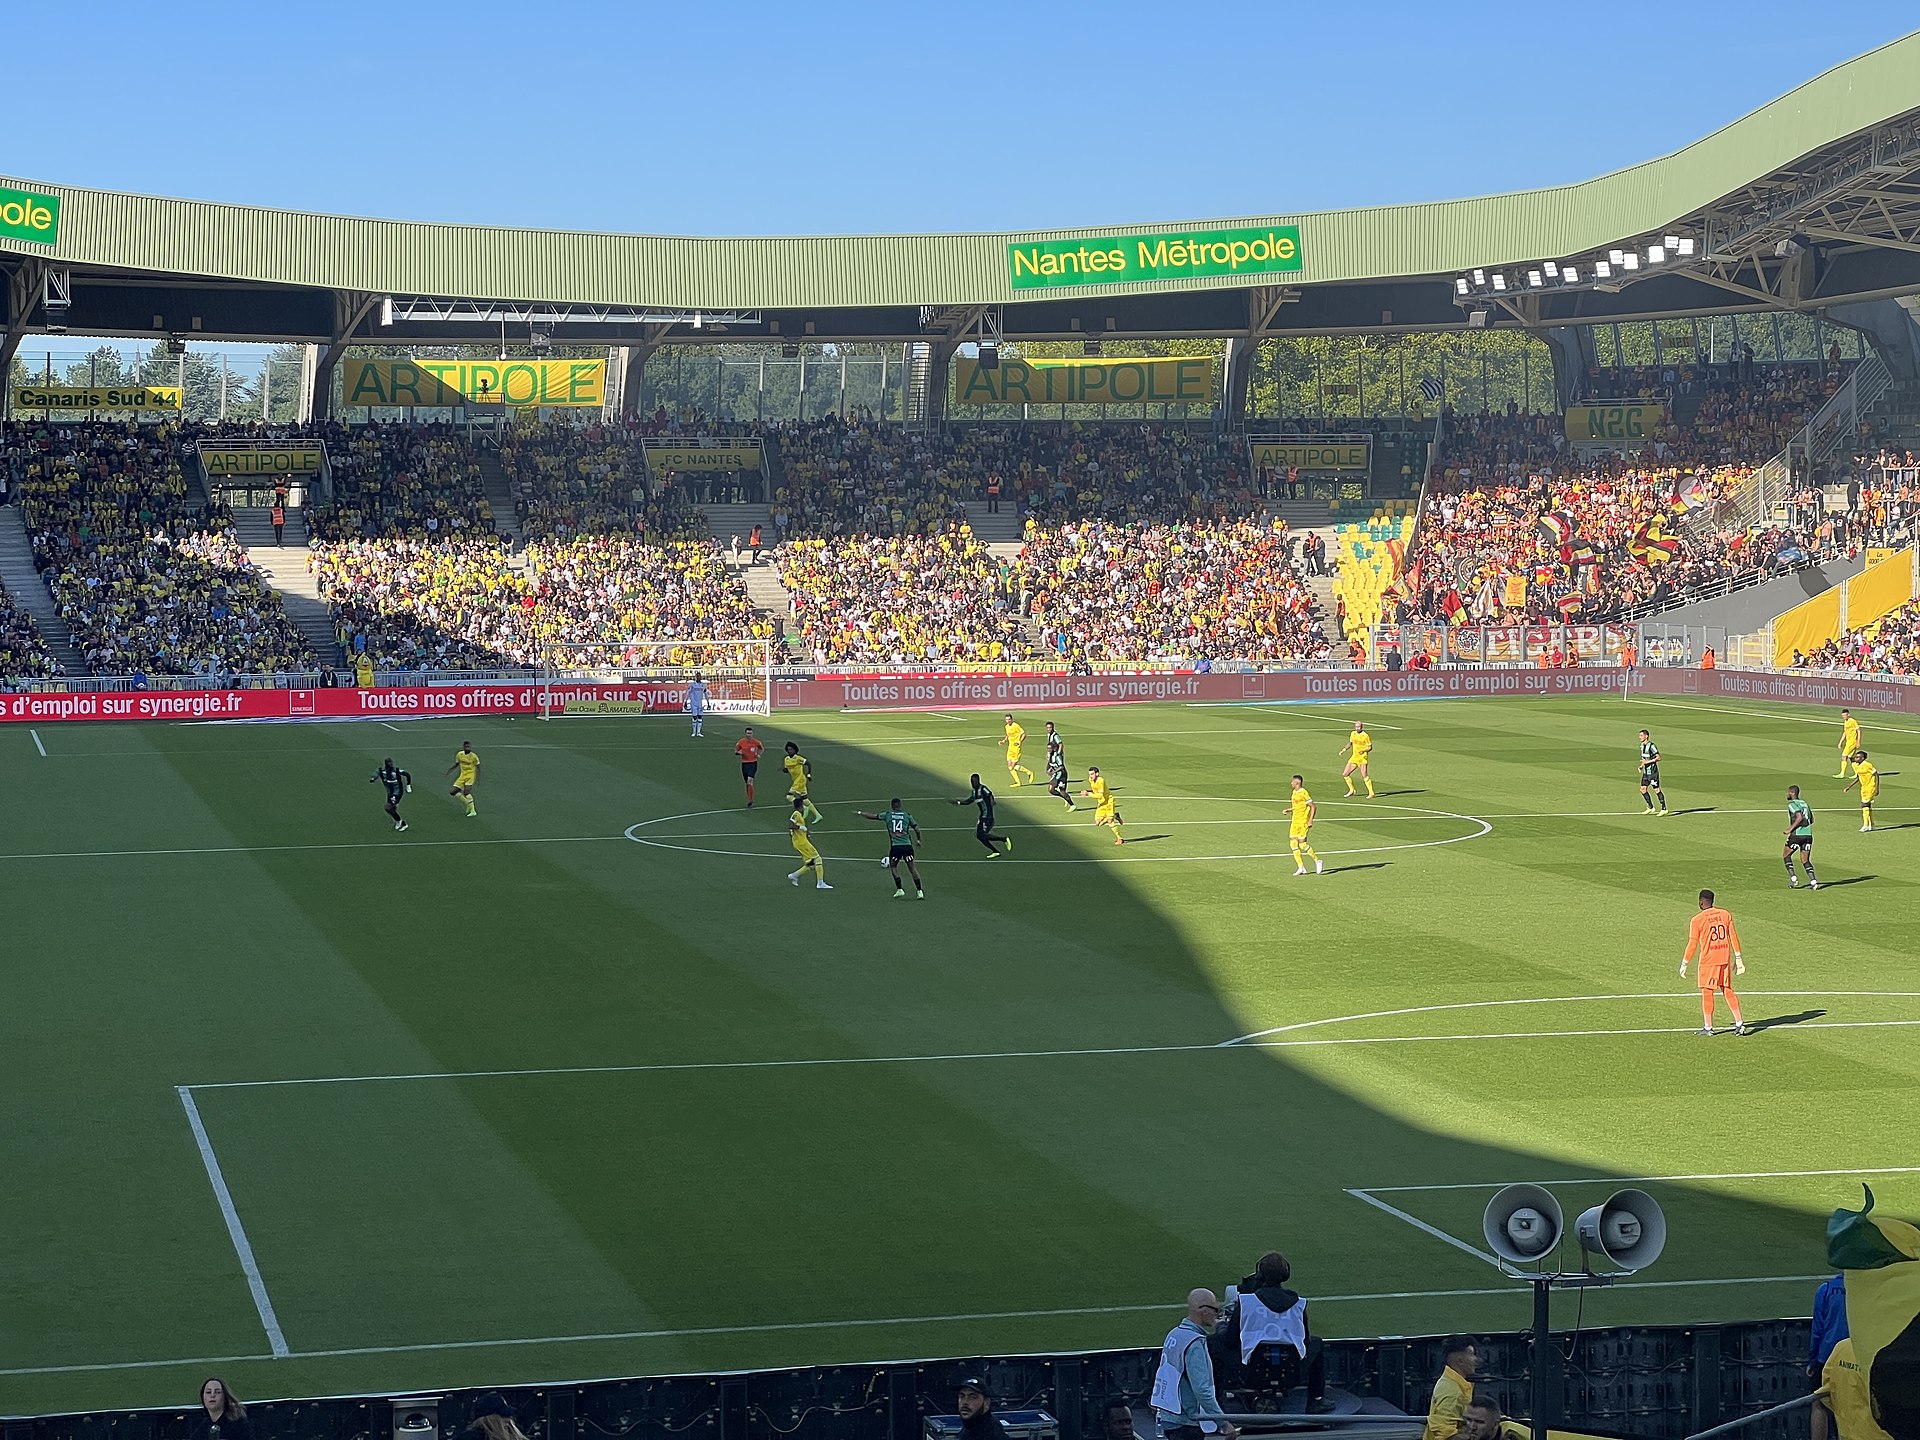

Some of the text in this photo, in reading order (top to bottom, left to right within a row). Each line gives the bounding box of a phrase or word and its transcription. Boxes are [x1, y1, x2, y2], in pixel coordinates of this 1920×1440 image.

[0, 198, 52, 230] ole
[1013, 247, 1127, 277] Nantes
[350, 362, 599, 404] ARTIPOLE
[963, 359, 1206, 401] ARTIPOLE
[18, 389, 178, 407] Canaris Sud 44
[1588, 408, 1643, 438] N2G
[208, 453, 317, 473] ARTIPOLE
[665, 454, 741, 467] FC NANTES
[1259, 448, 1362, 466] ARTIPOLE
[842, 683, 898, 701] Toutes
[905, 685, 935, 700] nos
[941, 682, 990, 699] offres
[1078, 682, 1104, 696] sur
[1109, 678, 1200, 699] synergie.fr
[1303, 675, 1357, 694] Toutes
[1362, 676, 1392, 692] nos
[1396, 672, 1444, 691] offres
[1524, 674, 1550, 689] sur
[1719, 674, 1750, 693] Toutes
[1752, 680, 1768, 695] nos
[1770, 678, 1796, 698] offres
[1841, 689, 1855, 701] sur
[1857, 685, 1903, 708] synergie.fr
[102, 698, 134, 714] sur
[140, 693, 242, 715] synergie.fr
[359, 690, 417, 708] Toutes
[424, 693, 456, 708] nos
[461, 688, 514, 709] offres
[892, 820, 903, 832] 14
[1710, 924, 1726, 942] 30
